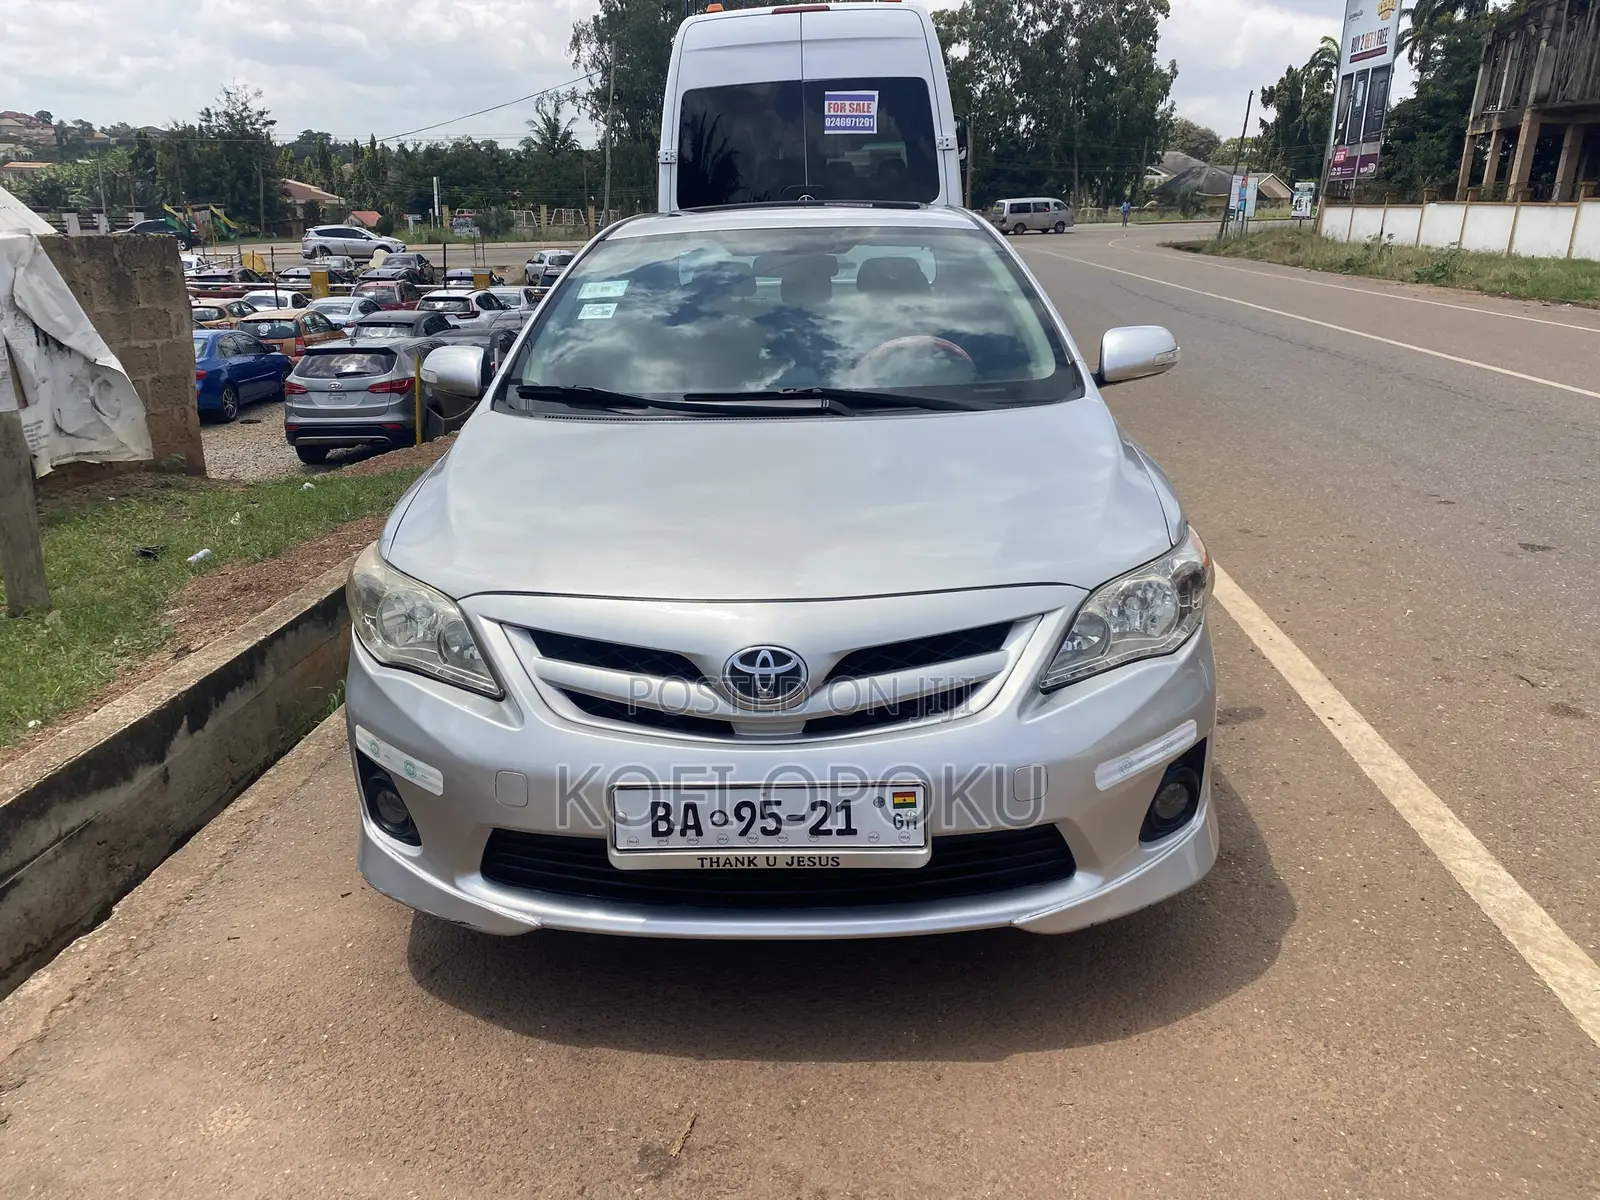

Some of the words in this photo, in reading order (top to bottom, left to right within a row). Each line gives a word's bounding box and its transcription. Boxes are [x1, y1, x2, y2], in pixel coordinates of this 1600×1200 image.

[828, 102, 846, 114] FOR
[848, 102, 872, 114] SALE
[825, 117, 873, 128] 0246971291
[650, 800, 704, 838] BA
[733, 798, 858, 837] 95-21
[697, 856, 758, 869] THANK
[766, 856, 777, 868] U
[785, 855, 841, 868] JESUS
